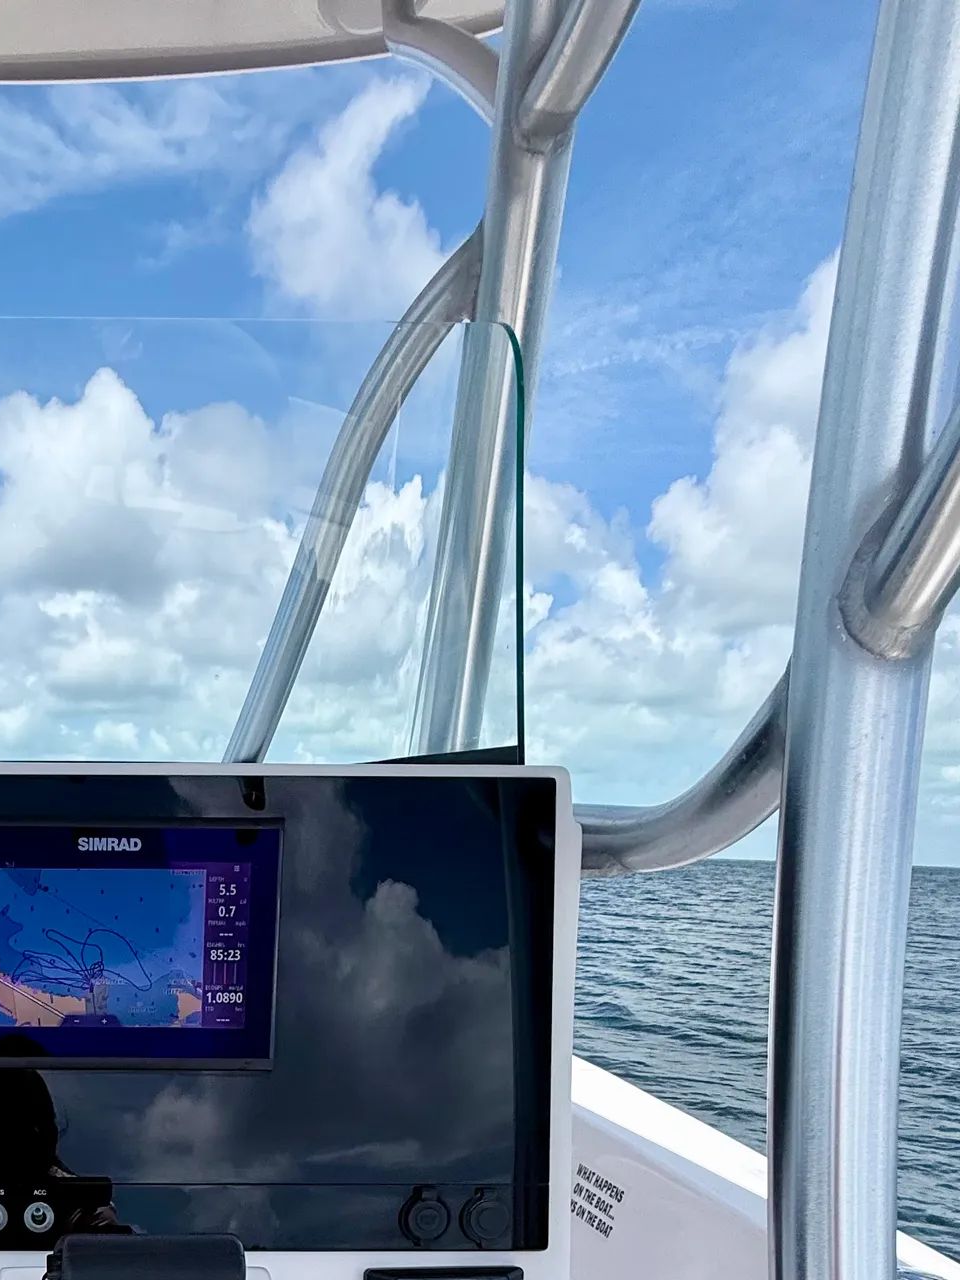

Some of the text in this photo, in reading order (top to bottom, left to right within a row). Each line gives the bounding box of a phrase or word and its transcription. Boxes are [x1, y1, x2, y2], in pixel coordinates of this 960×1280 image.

[78, 837, 142, 851] SIMRAD
[219, 884, 237, 896] 5.5
[218, 906, 236, 917] 0.7
[210, 950, 241, 961] 85:23
[206, 992, 243, 1004] 1.0890
[576, 1164, 625, 1203] WHAT HAPPENS
[574, 1182, 585, 1197] ON
[582, 1188, 597, 1206] THE
[576, 1205, 587, 1220] ON
[584, 1210, 598, 1228] THE
[595, 1218, 613, 1238] BOAT
